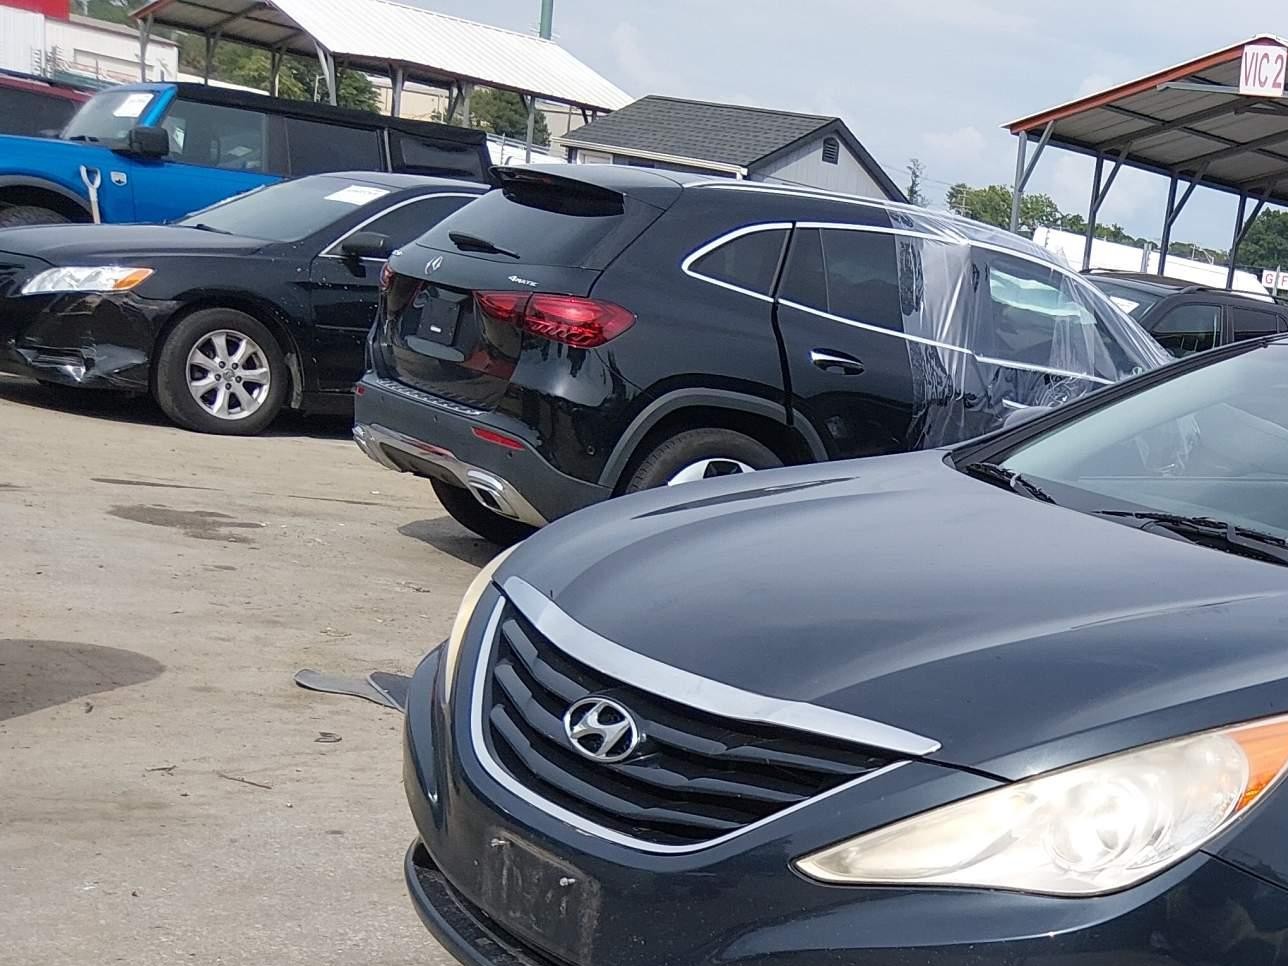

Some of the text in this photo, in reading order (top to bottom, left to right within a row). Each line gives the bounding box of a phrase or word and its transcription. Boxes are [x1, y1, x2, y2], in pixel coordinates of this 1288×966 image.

[1244, 51, 1285, 89] VIC 2
[1265, 273, 1288, 287] G F
